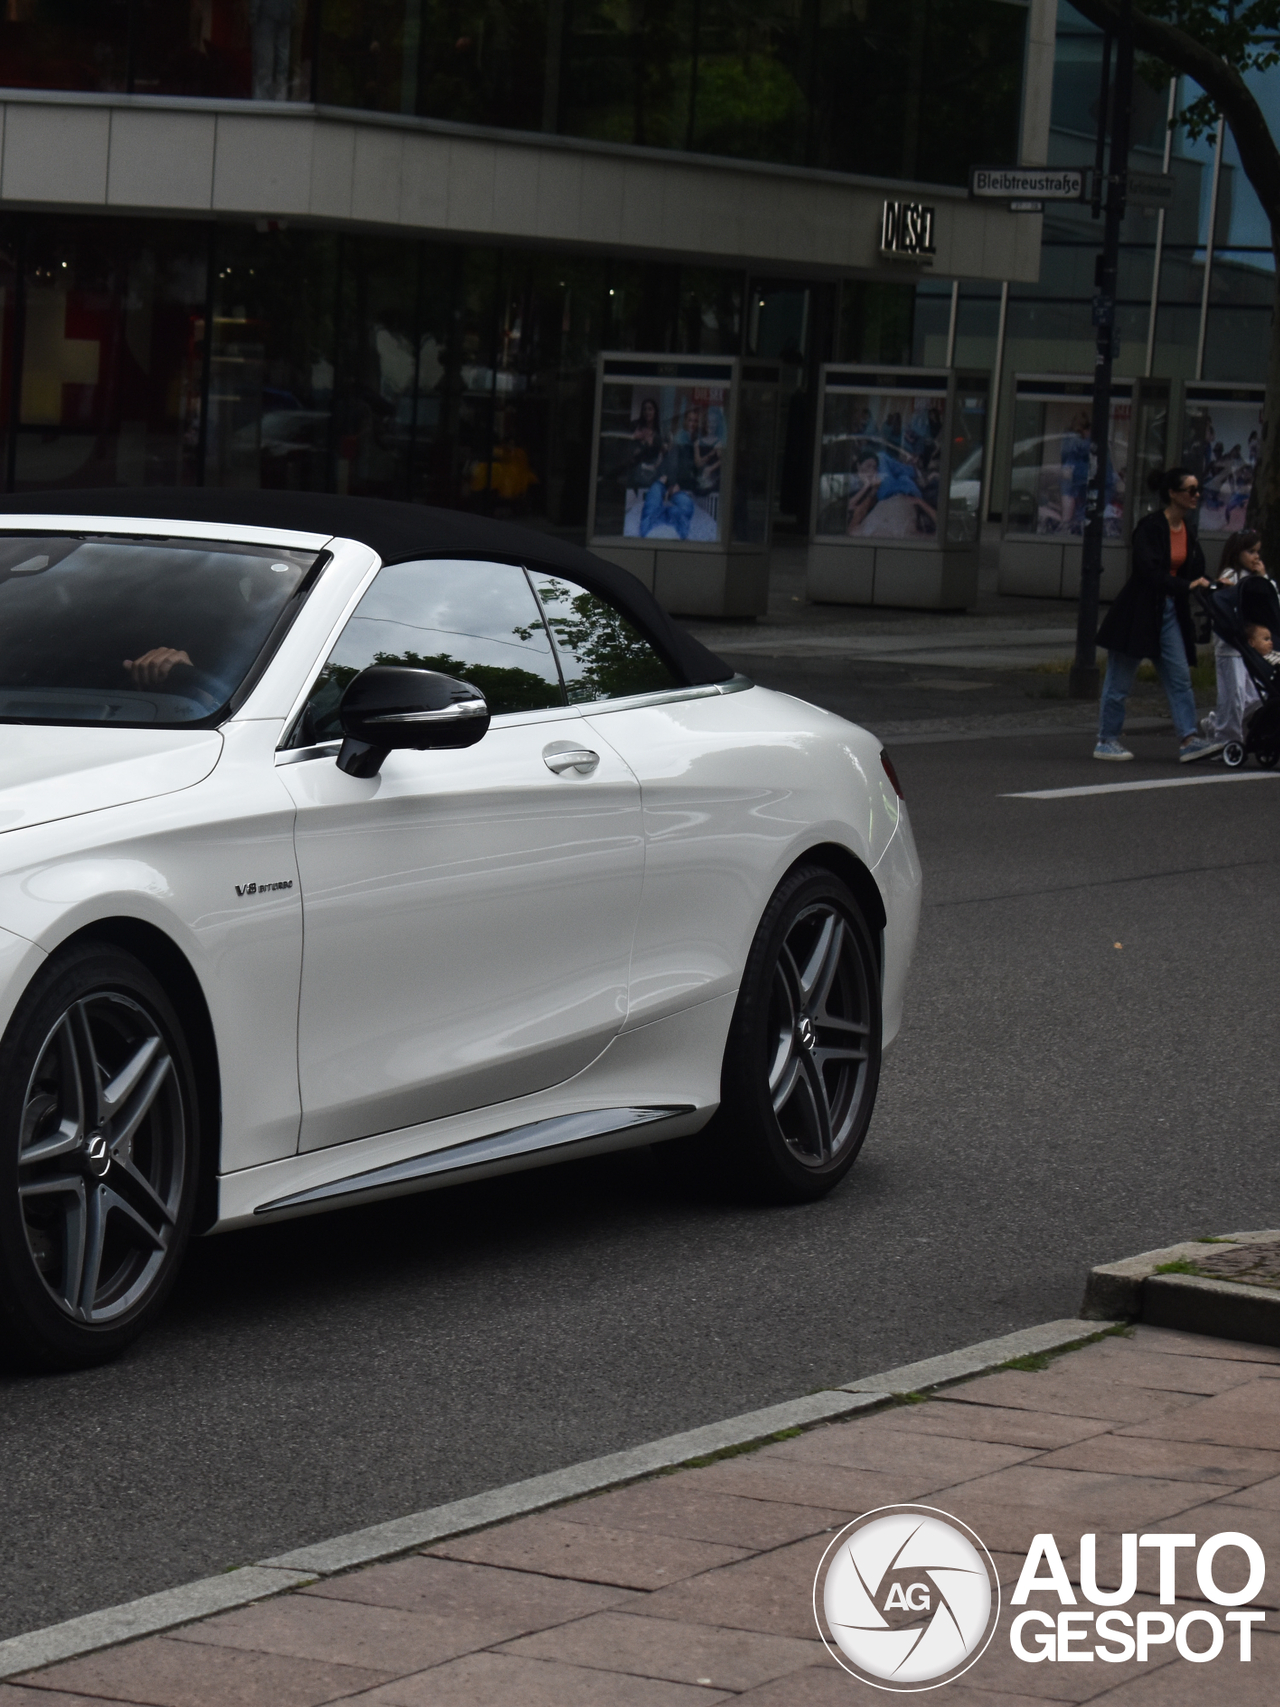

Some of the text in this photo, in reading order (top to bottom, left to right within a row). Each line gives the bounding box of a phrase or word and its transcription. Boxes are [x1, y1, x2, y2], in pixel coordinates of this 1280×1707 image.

[976, 172, 1081, 195] Bleibtreustraße
[880, 199, 936, 254] DIESEL
[235, 880, 293, 896] V8 BITURBO
